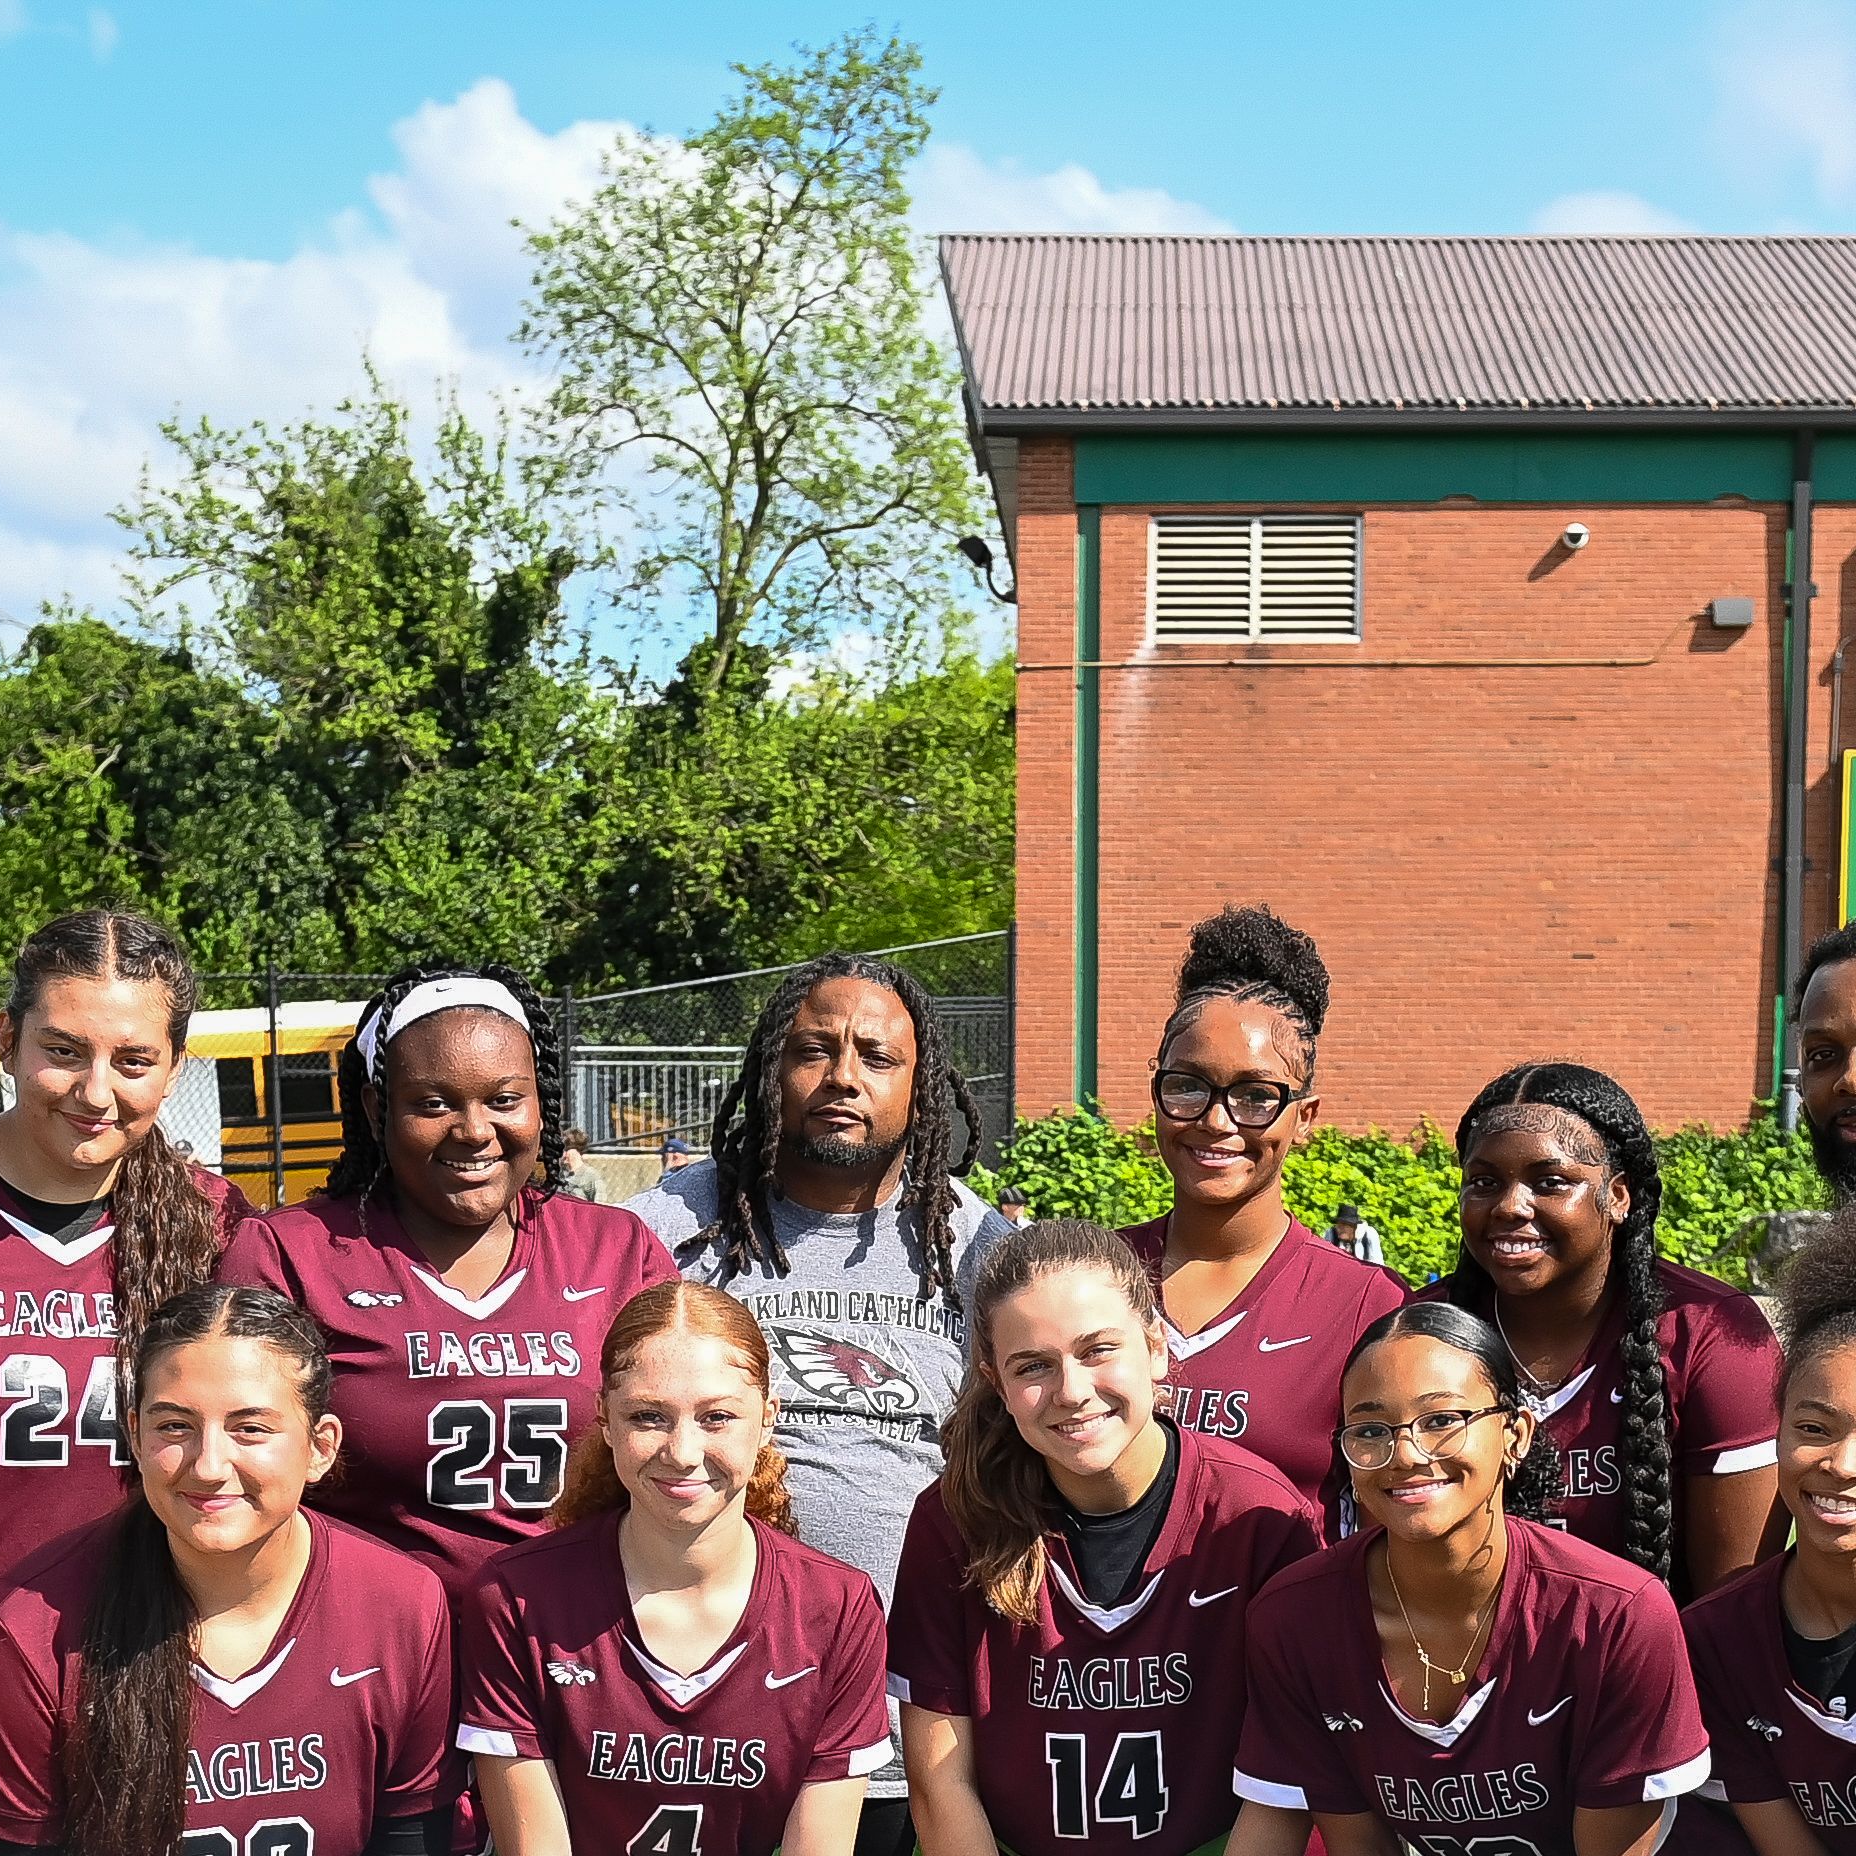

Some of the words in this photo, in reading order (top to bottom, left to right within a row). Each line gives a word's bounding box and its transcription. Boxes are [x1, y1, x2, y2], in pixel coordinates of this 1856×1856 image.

[742, 1289, 839, 1322] KLAND
[848, 1290, 966, 1346] CATHOLIC
[405, 1330, 581, 1379] EAGLES
[427, 1400, 569, 1510] 25
[1027, 1652, 1193, 1710] EAGLES
[185, 1733, 328, 1804] AGLES
[587, 1729, 767, 1788] EAGLES
[1045, 1730, 1169, 1840] 14
[1374, 1763, 1550, 1824] EAGLES
